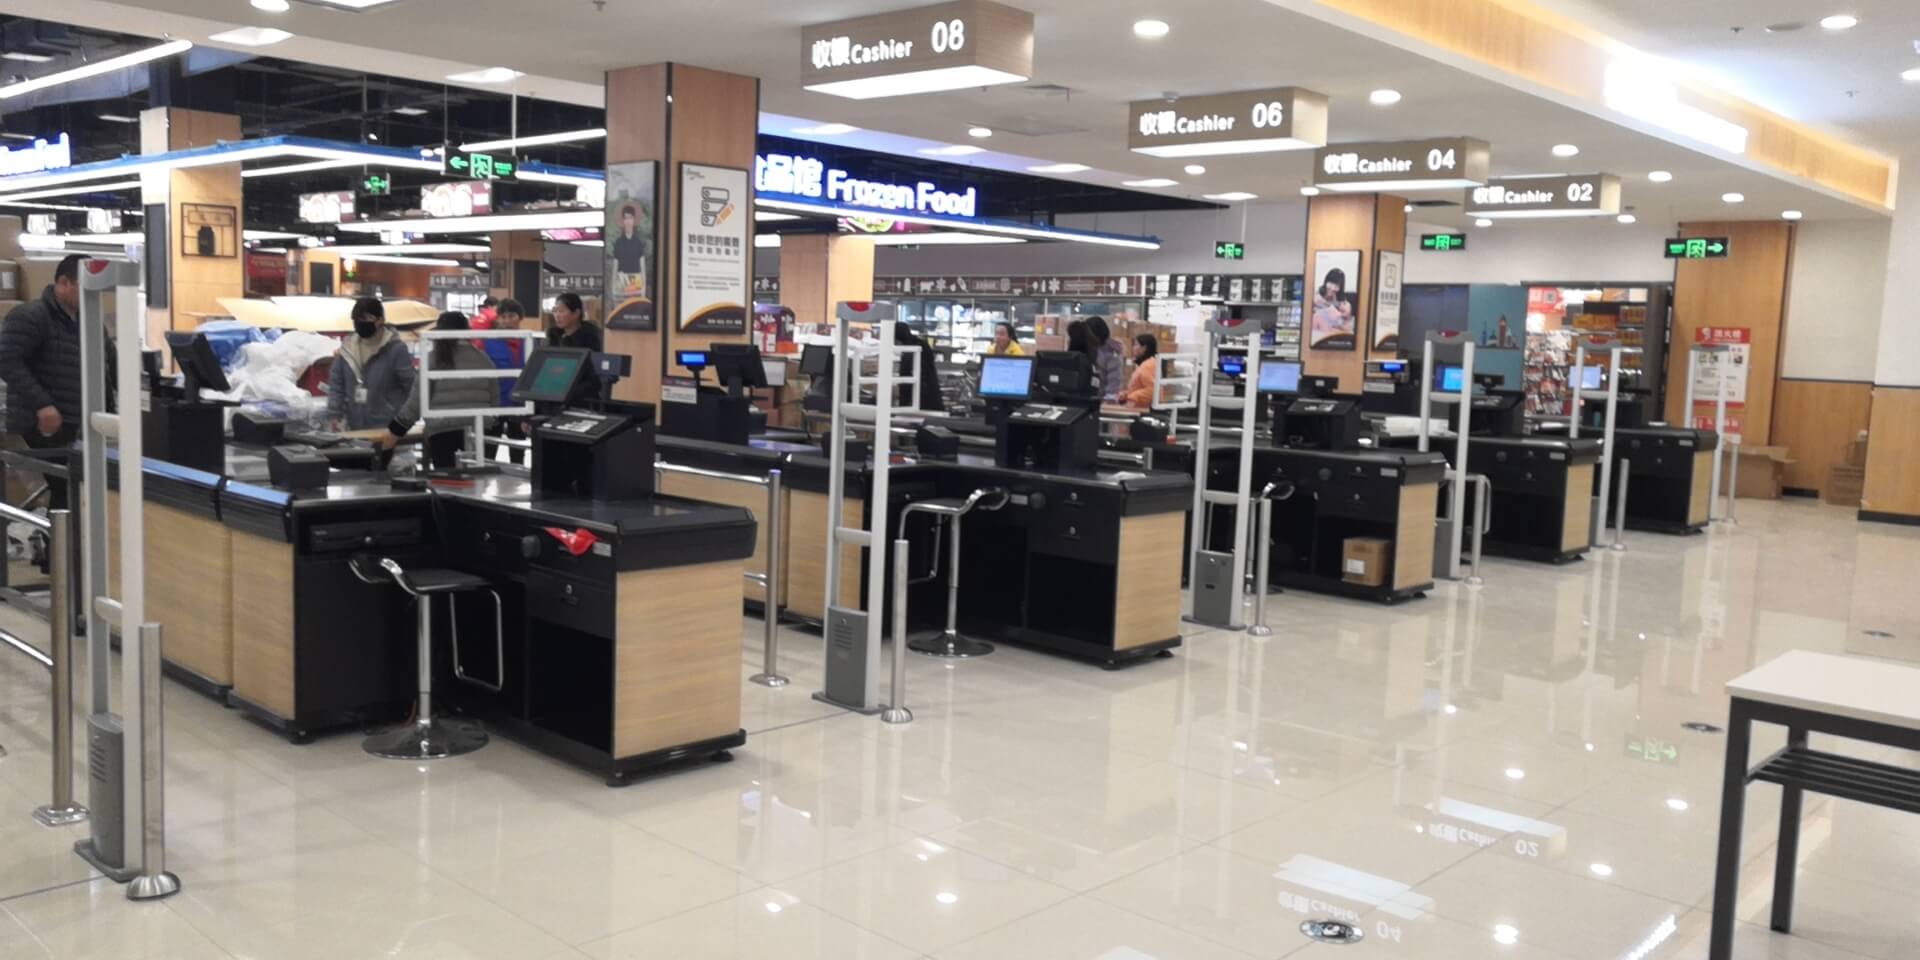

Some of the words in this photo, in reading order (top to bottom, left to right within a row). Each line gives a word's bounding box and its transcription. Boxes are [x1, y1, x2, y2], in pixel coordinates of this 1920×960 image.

[851, 38, 913, 64] Cashier
[931, 18, 965, 53] 08
[1177, 113, 1235, 134] Cashier
[1251, 101, 1283, 128] 06
[1358, 156, 1413, 174] Cashier
[1427, 147, 1456, 171] 04
[826, 168, 915, 210] Frozen
[916, 181, 976, 218] Food
[1504, 189, 1554, 204] Cashier
[1567, 182, 1593, 202] 02
